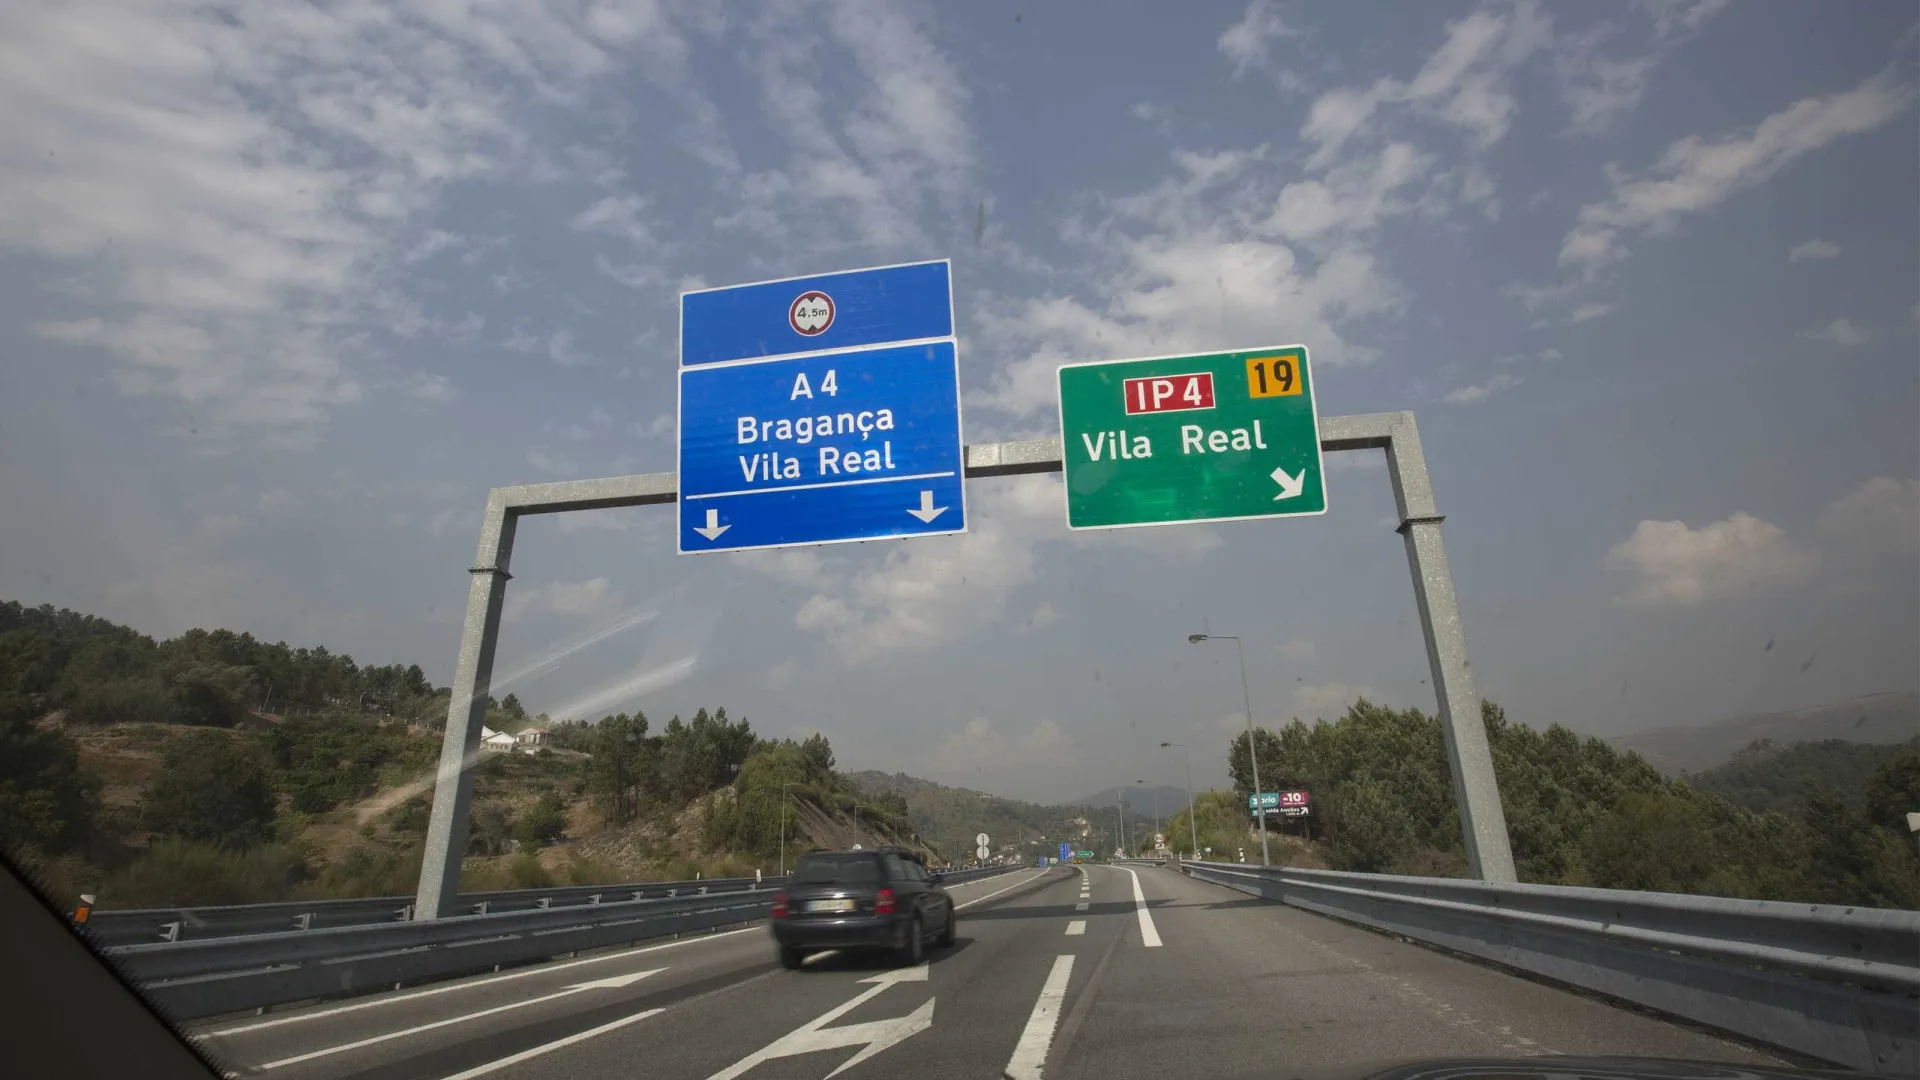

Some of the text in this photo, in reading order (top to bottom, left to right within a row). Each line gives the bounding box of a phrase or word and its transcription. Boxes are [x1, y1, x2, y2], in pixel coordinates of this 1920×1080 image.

[1255, 360, 1293, 393] 19
[738, 409, 895, 445] Bragança
[1082, 420, 1267, 461] Vila Real
[740, 441, 896, 482] Vila Real
